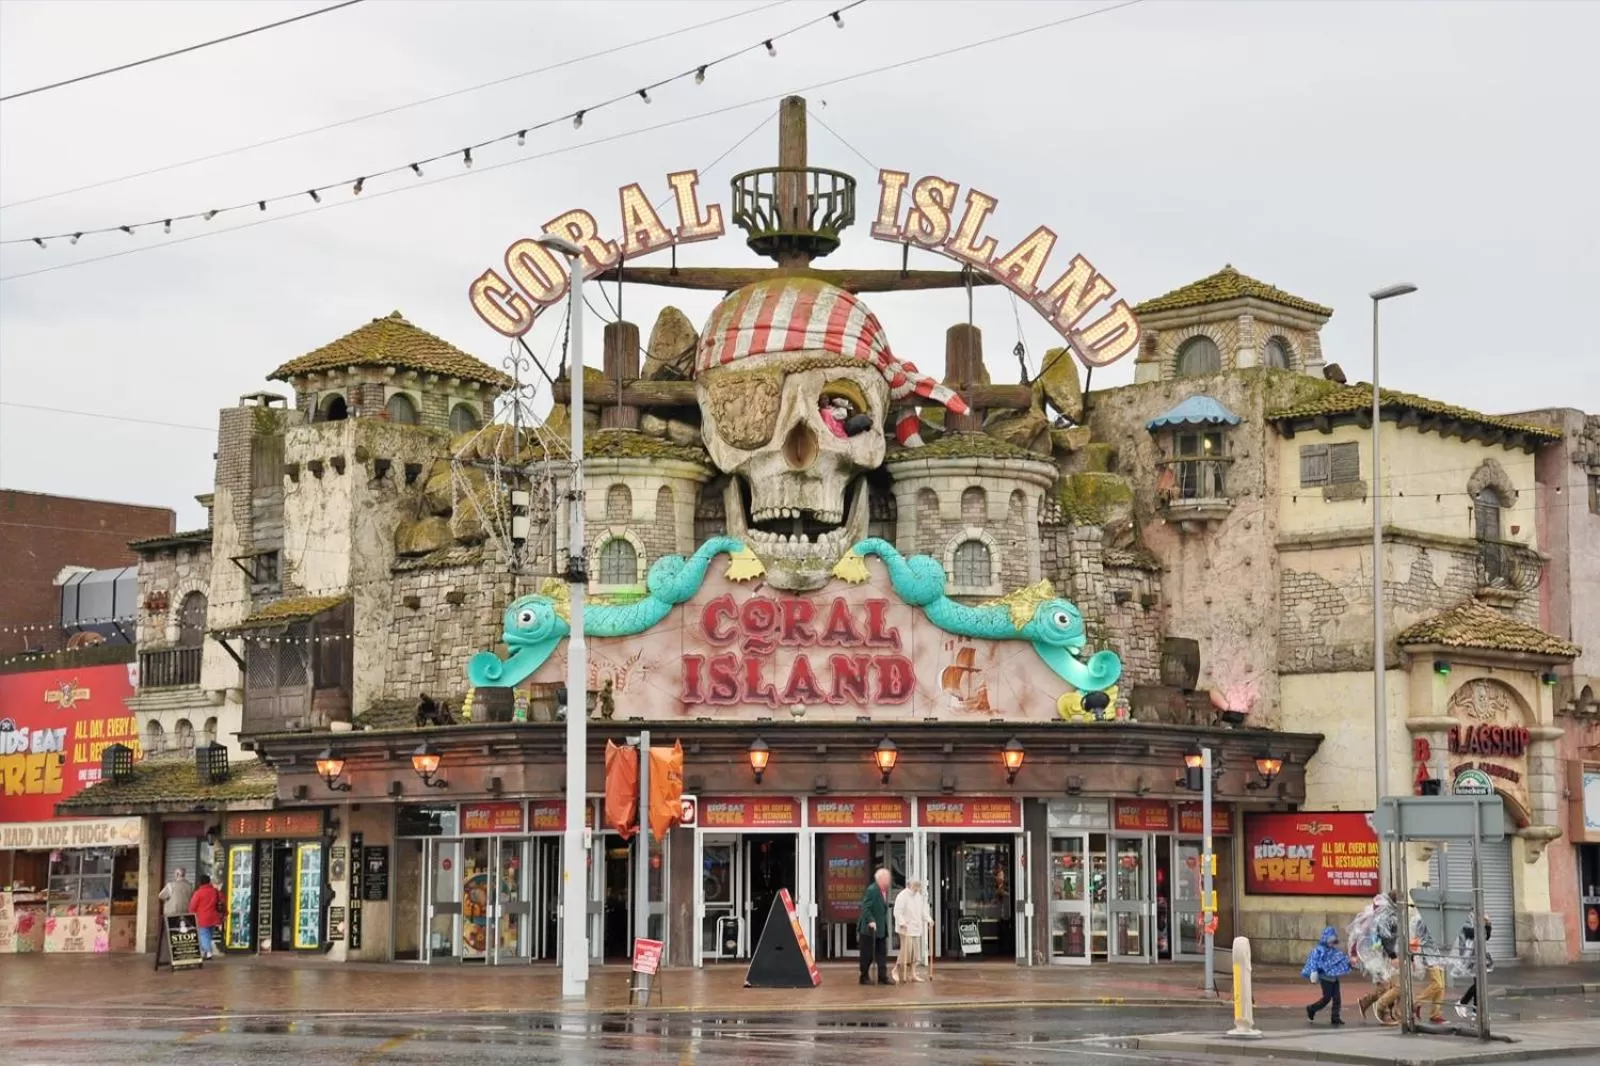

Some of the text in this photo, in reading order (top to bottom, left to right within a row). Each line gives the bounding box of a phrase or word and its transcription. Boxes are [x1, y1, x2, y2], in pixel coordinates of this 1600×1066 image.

[467, 168, 1143, 368] CORAL ISLAND
[701, 592, 903, 650] CORAL
[681, 652, 917, 707] ISLAND
[75, 720, 88, 740] ALL
[107, 716, 130, 737] EVERY
[0, 727, 68, 754] IDS EAT
[1448, 723, 1530, 757] FLAGSHIP
[73, 743, 88, 763] ALL
[37, 826, 69, 846] MADE
[72, 824, 109, 844] FUDGE
[1254, 843, 1315, 859] KIDS EAT
[1322, 842, 1332, 854] ALL
[1348, 842, 1367, 854] EVERY
[1254, 858, 1315, 882] FREE
[1322, 856, 1379, 869] ALL RESTAURANTS
[171, 932, 197, 942] STOP
[960, 922, 977, 932] cash
[962, 935, 979, 944] here
